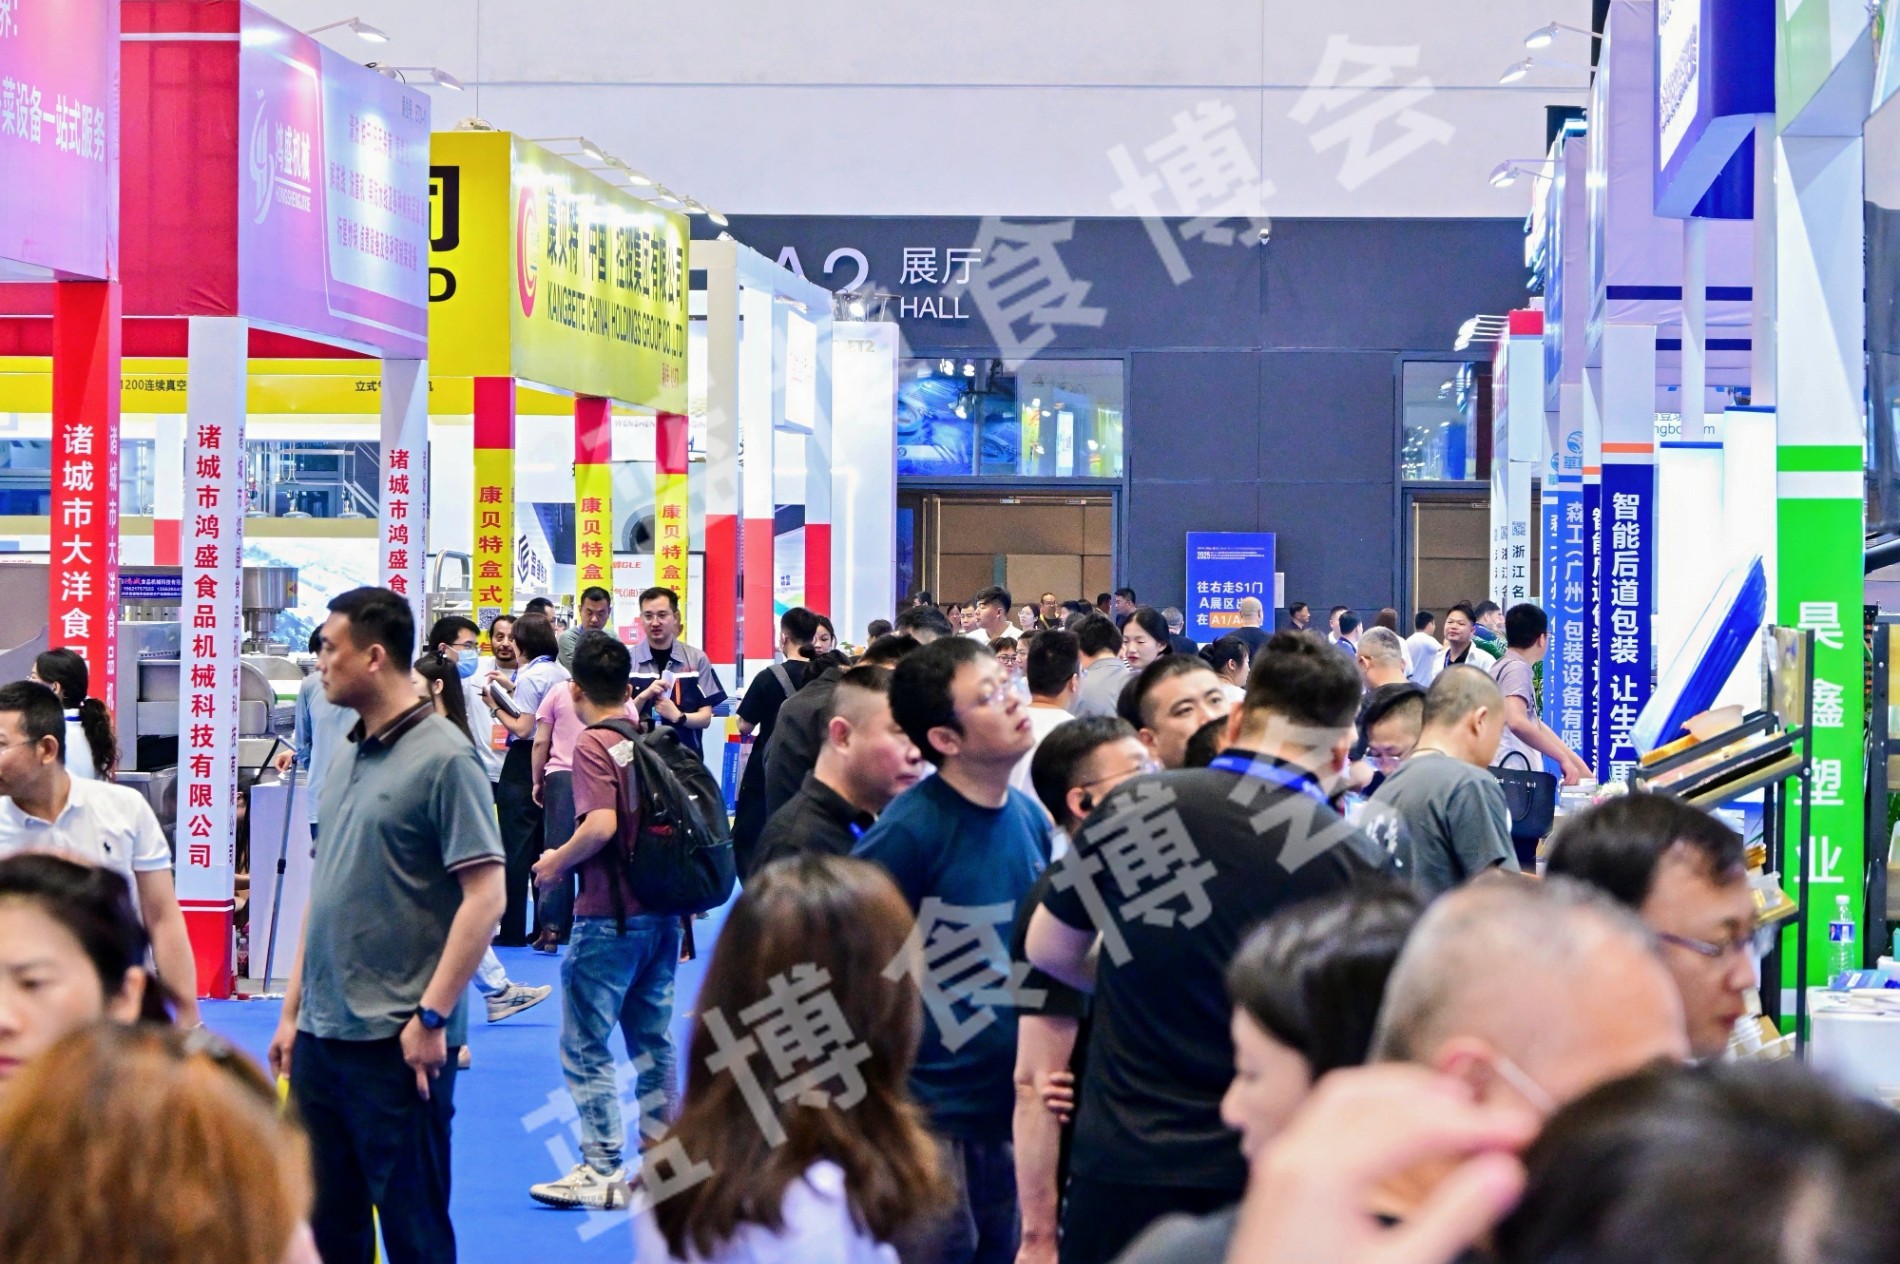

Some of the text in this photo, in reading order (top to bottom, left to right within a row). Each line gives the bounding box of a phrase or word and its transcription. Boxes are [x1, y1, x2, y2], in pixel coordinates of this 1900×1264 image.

[900, 247, 982, 285] 展厅
[900, 296, 969, 319] HALL
[387, 449, 410, 595] 诸城市鸿盛食
[479, 486, 503, 604] 康贝特盒式
[1610, 491, 1640, 665] 智能后道包装
[188, 424, 222, 869] 诸城市鸿盛食品机械科技有限公司
[1196, 581, 1263, 594] 往右走S1门
[1196, 613, 1244, 626] 在 A1/A
[1793, 602, 1845, 883] 昊鑫塑业
